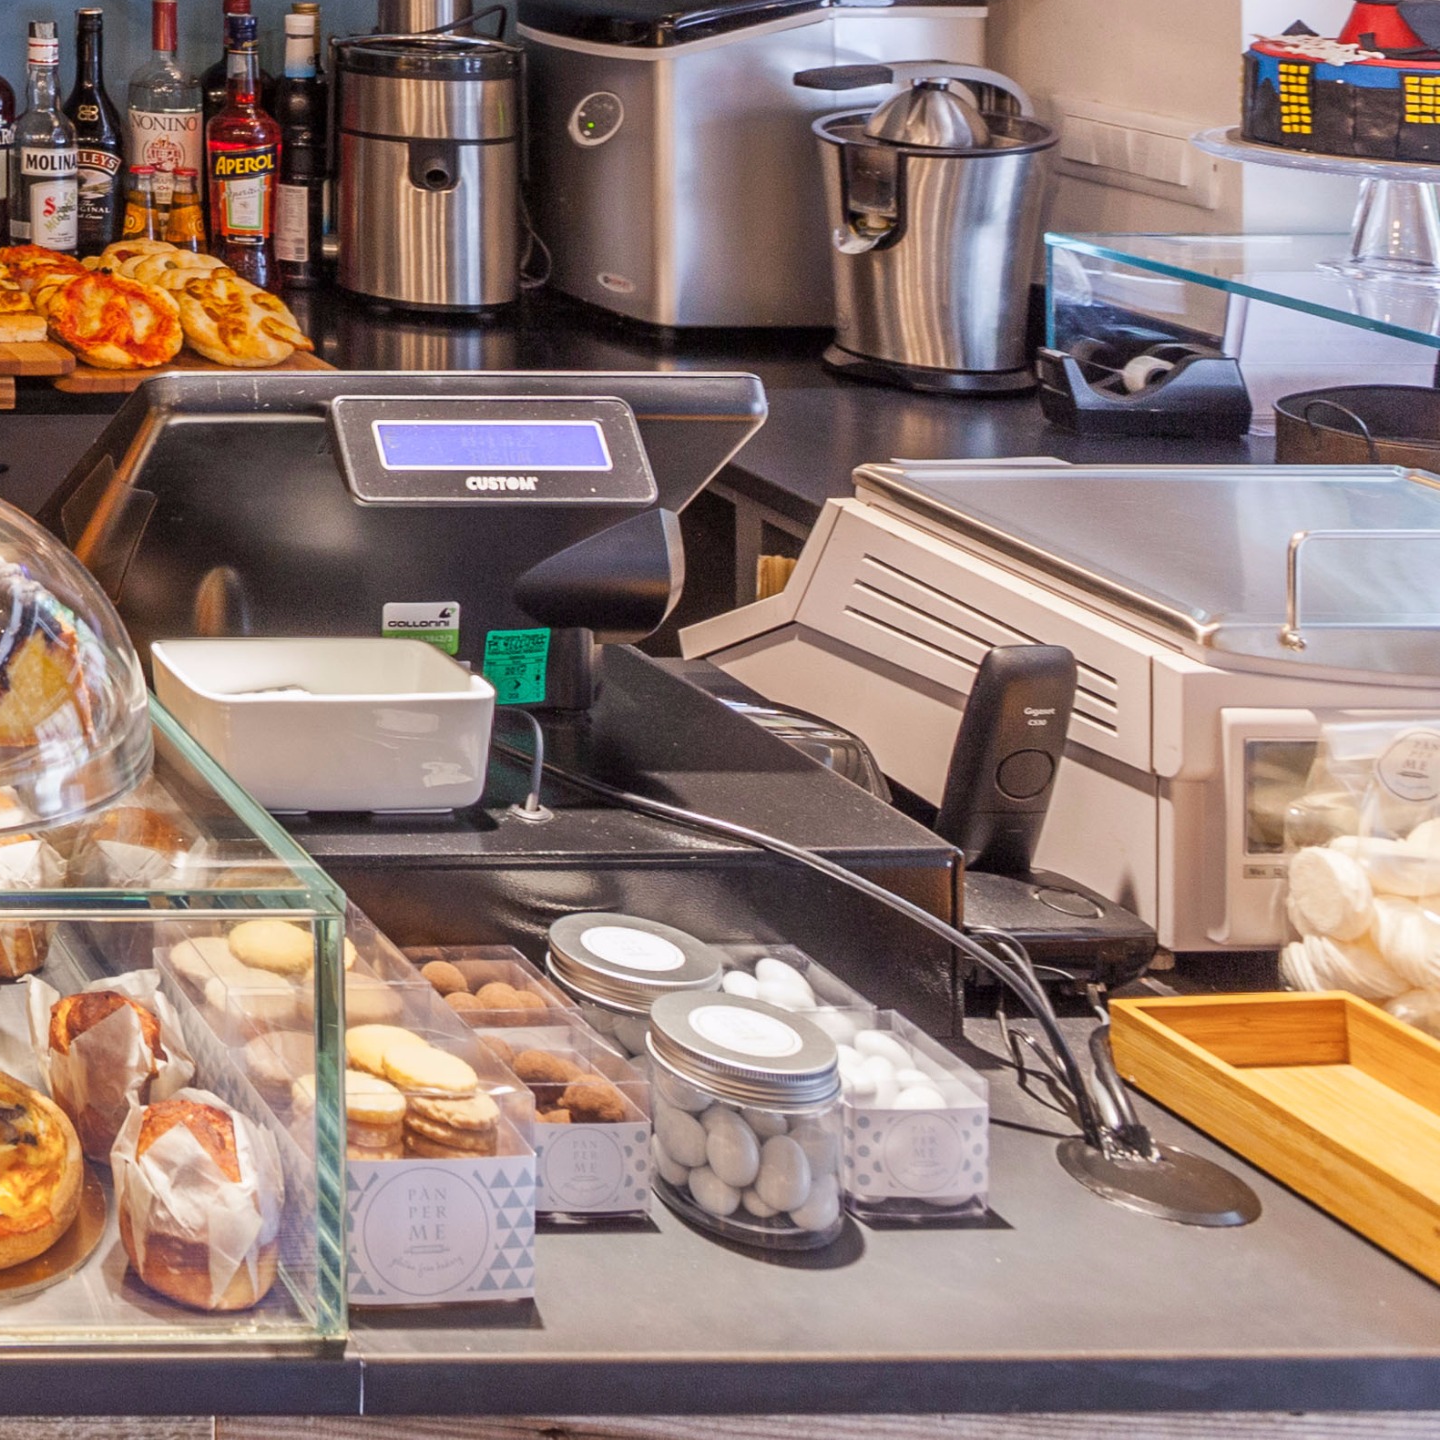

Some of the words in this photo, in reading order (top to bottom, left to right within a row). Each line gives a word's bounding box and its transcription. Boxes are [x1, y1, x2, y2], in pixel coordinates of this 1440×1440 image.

[131, 113, 198, 132] NONINO
[216, 154, 274, 175] APEROL
[465, 476, 536, 491] CUSTOM
[1023, 707, 1056, 717] Gigaset
[408, 1185, 448, 1202] PAN
[408, 1205, 448, 1220] PER
[408, 1223, 446, 1242] ME
